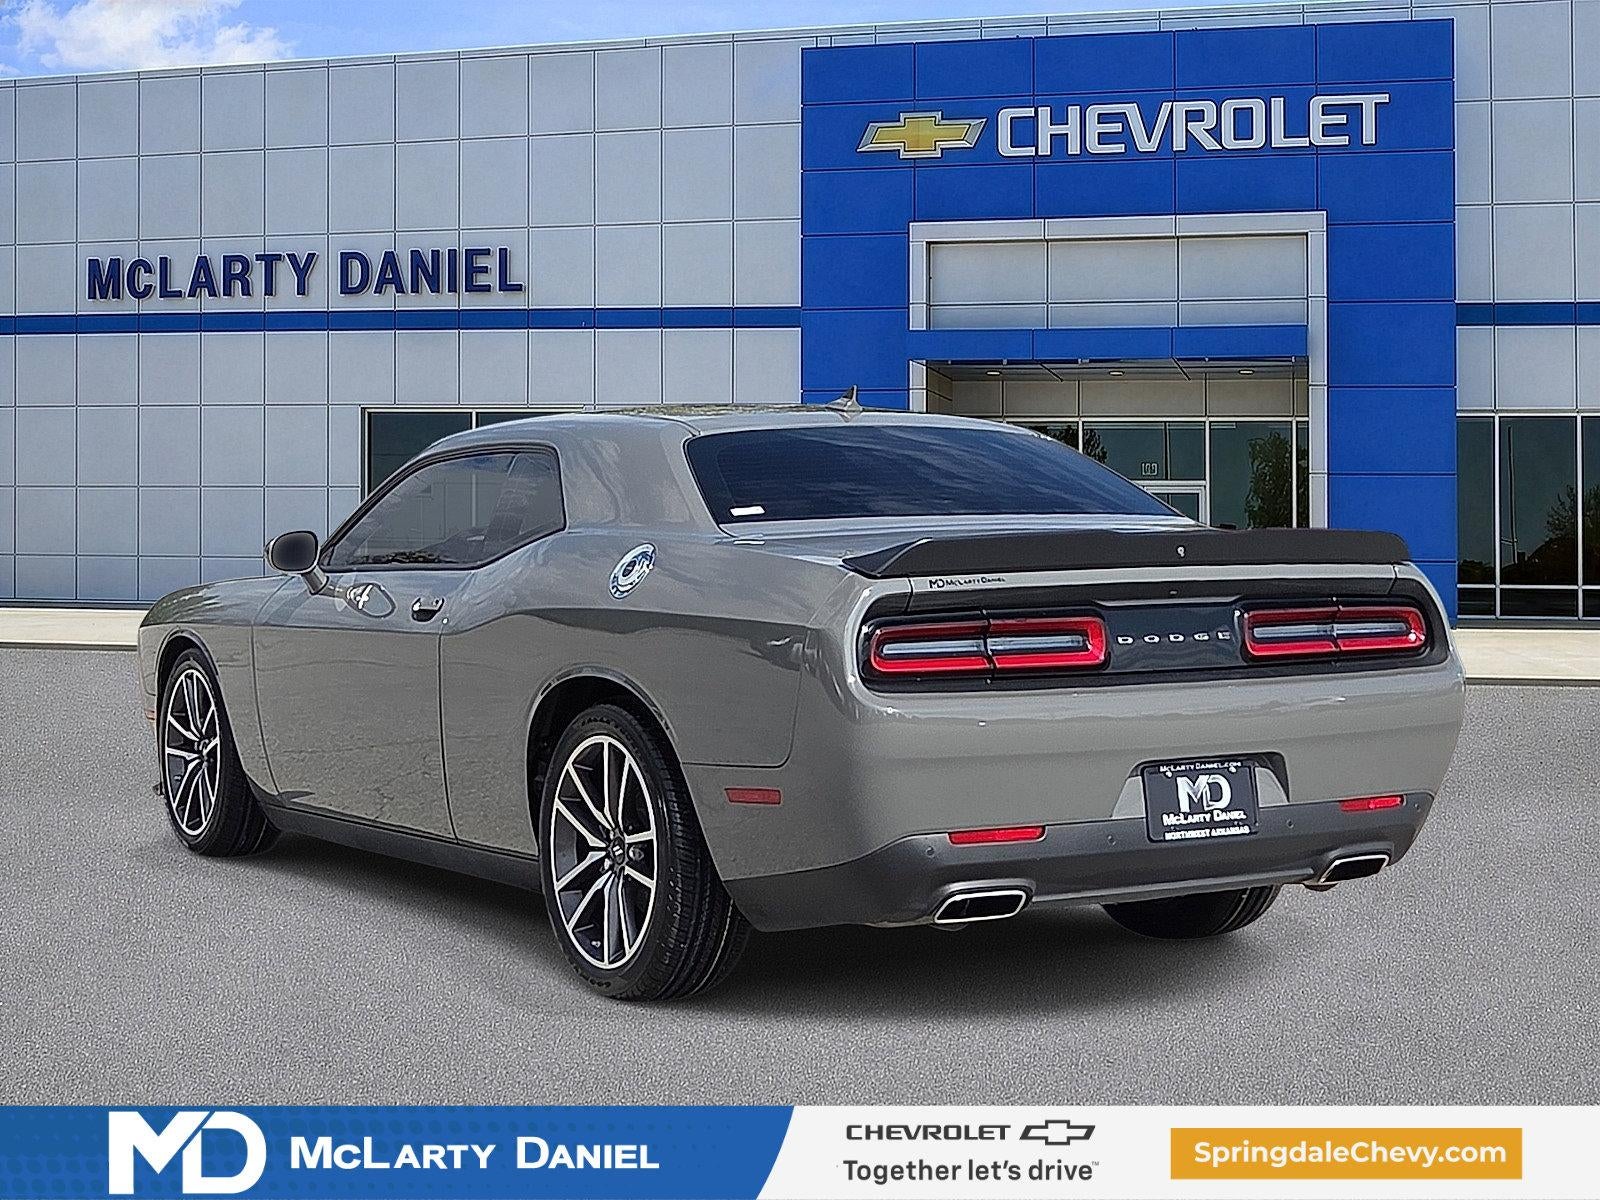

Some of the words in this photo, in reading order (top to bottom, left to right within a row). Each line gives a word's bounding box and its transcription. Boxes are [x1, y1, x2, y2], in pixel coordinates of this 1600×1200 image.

[996, 93, 1390, 157] CHEVROLET
[87, 252, 318, 301] MCLARTY
[339, 246, 526, 296] DANIEL
[1116, 630, 1233, 645] DODGE
[1175, 774, 1232, 813] MD
[1213, 809, 1247, 822] DANIEL
